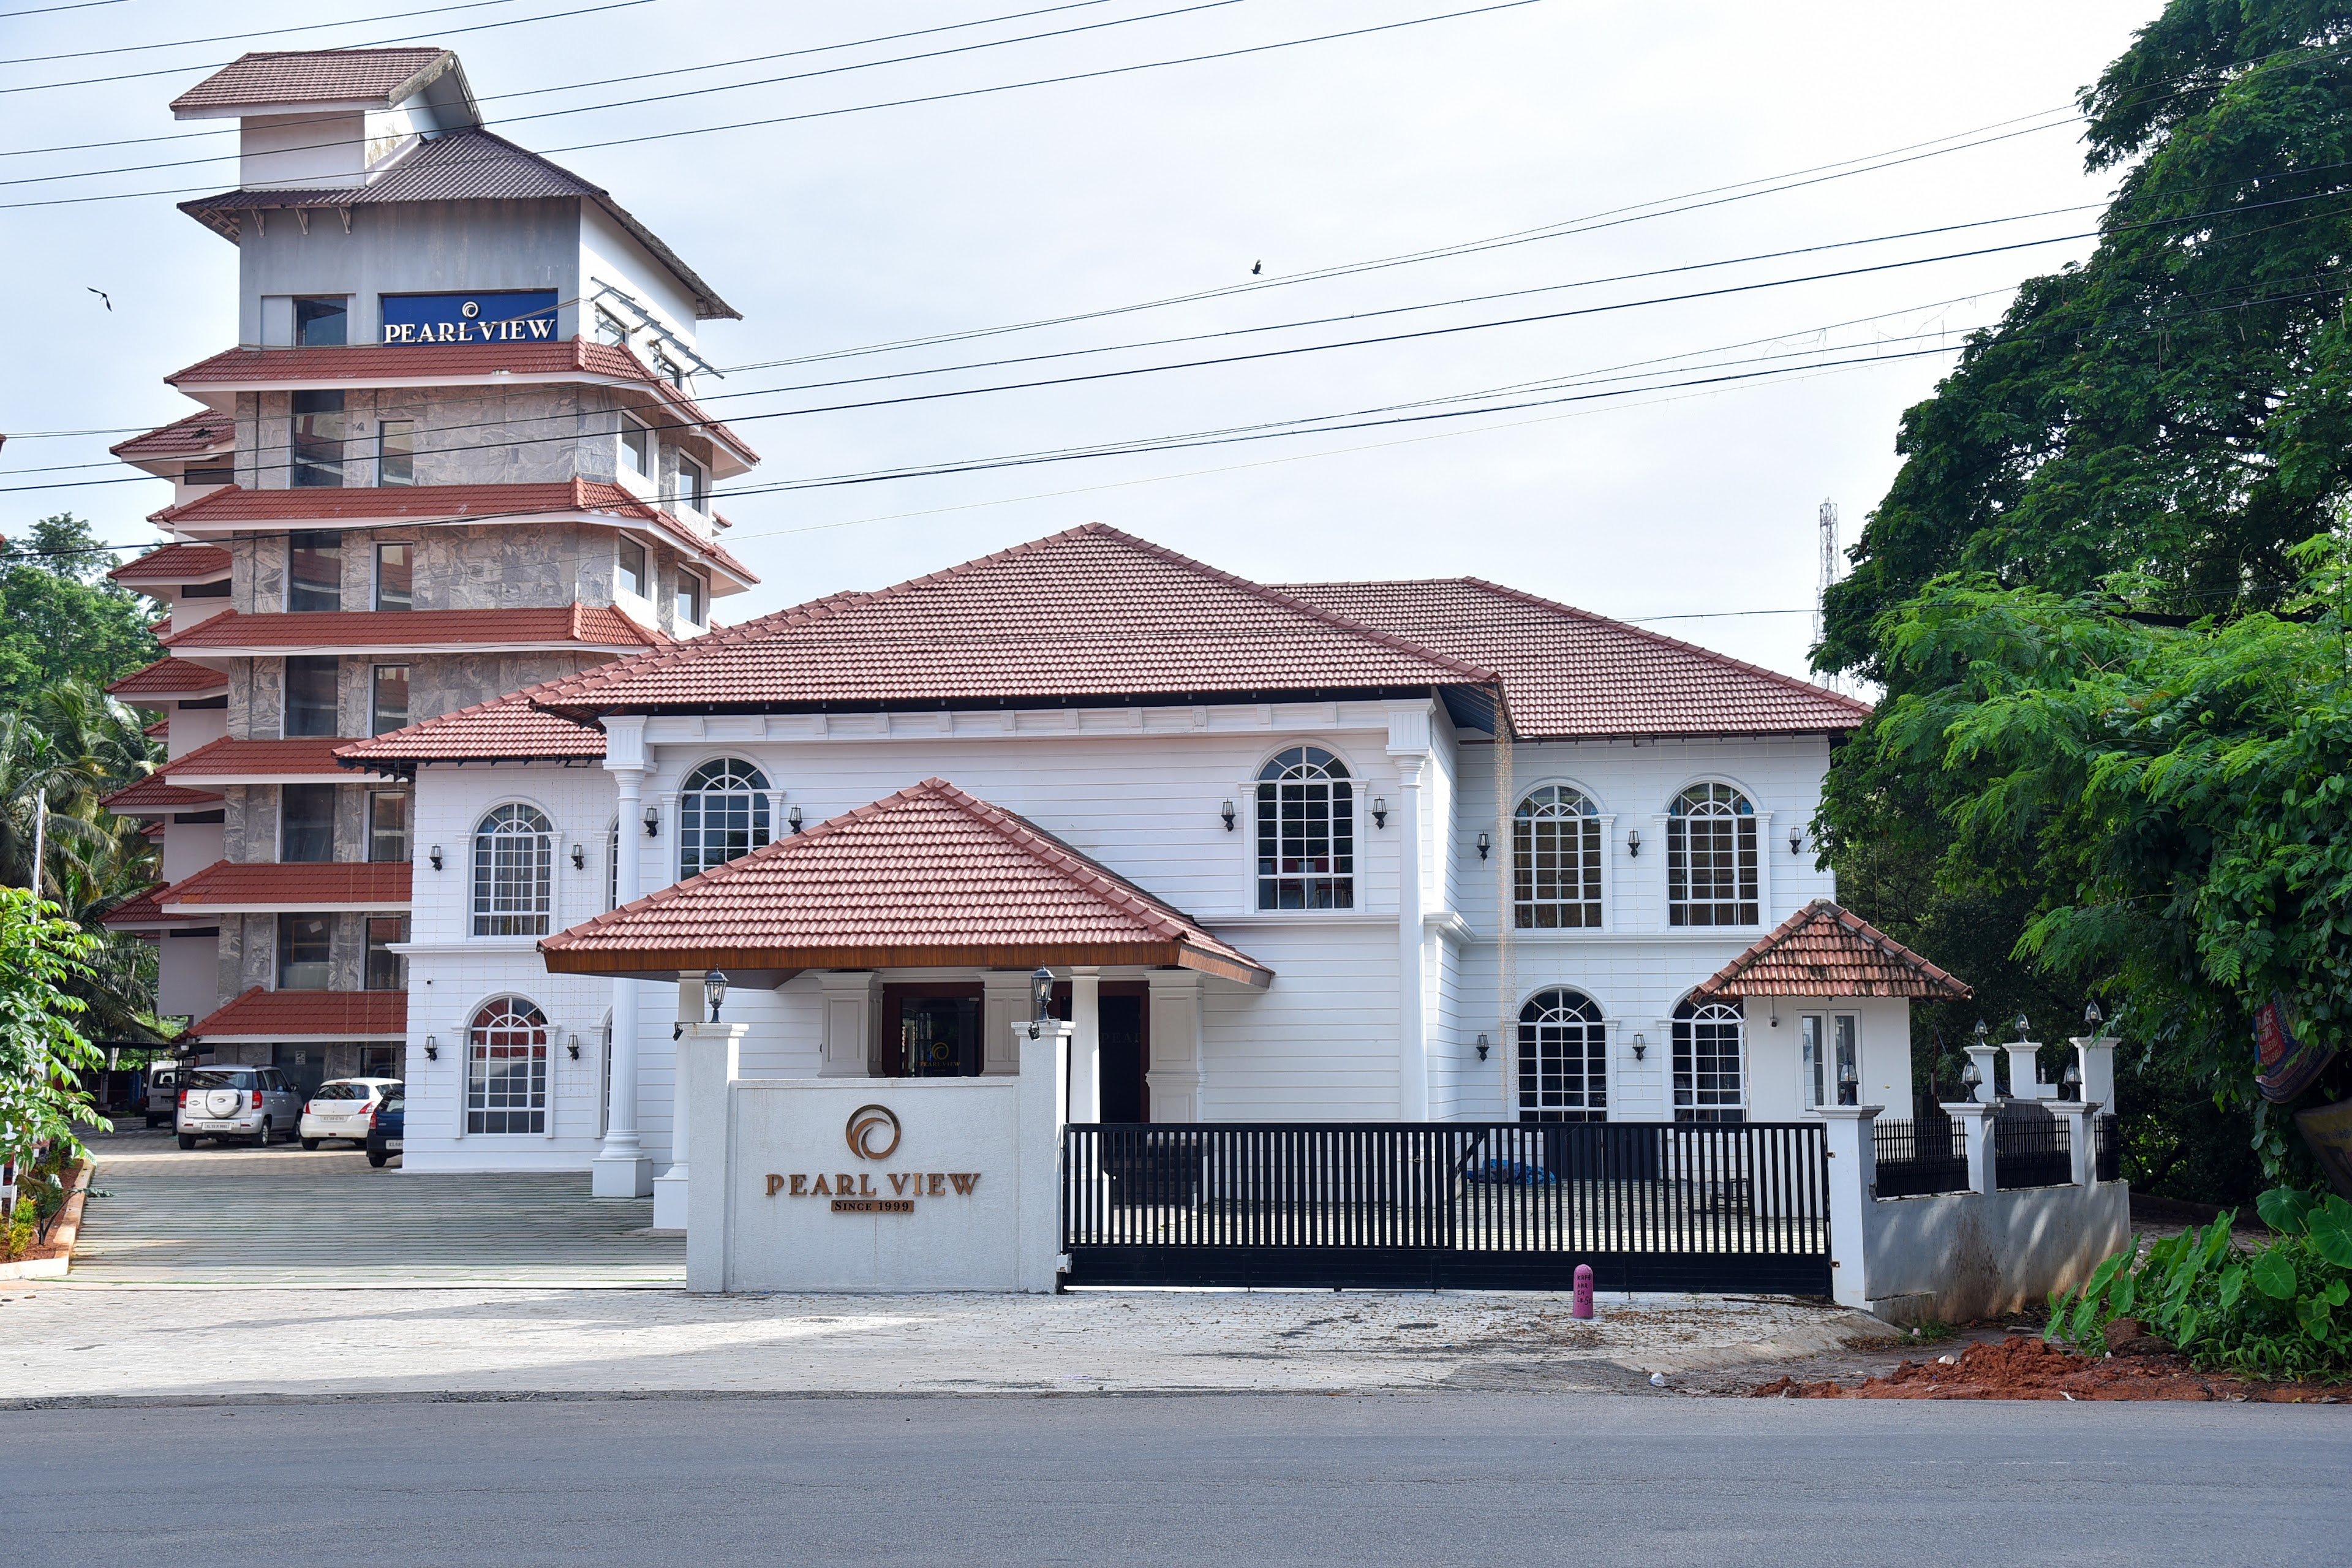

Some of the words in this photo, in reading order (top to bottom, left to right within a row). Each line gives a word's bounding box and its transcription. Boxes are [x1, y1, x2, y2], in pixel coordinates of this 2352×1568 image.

[384, 322, 473, 344] PEARL
[478, 319, 556, 341] VIEW
[764, 1173, 876, 1196] PEARL
[887, 1173, 981, 1195] VIEW
[835, 1201, 872, 1211] SINCE
[878, 1202, 909, 1211] 1999
